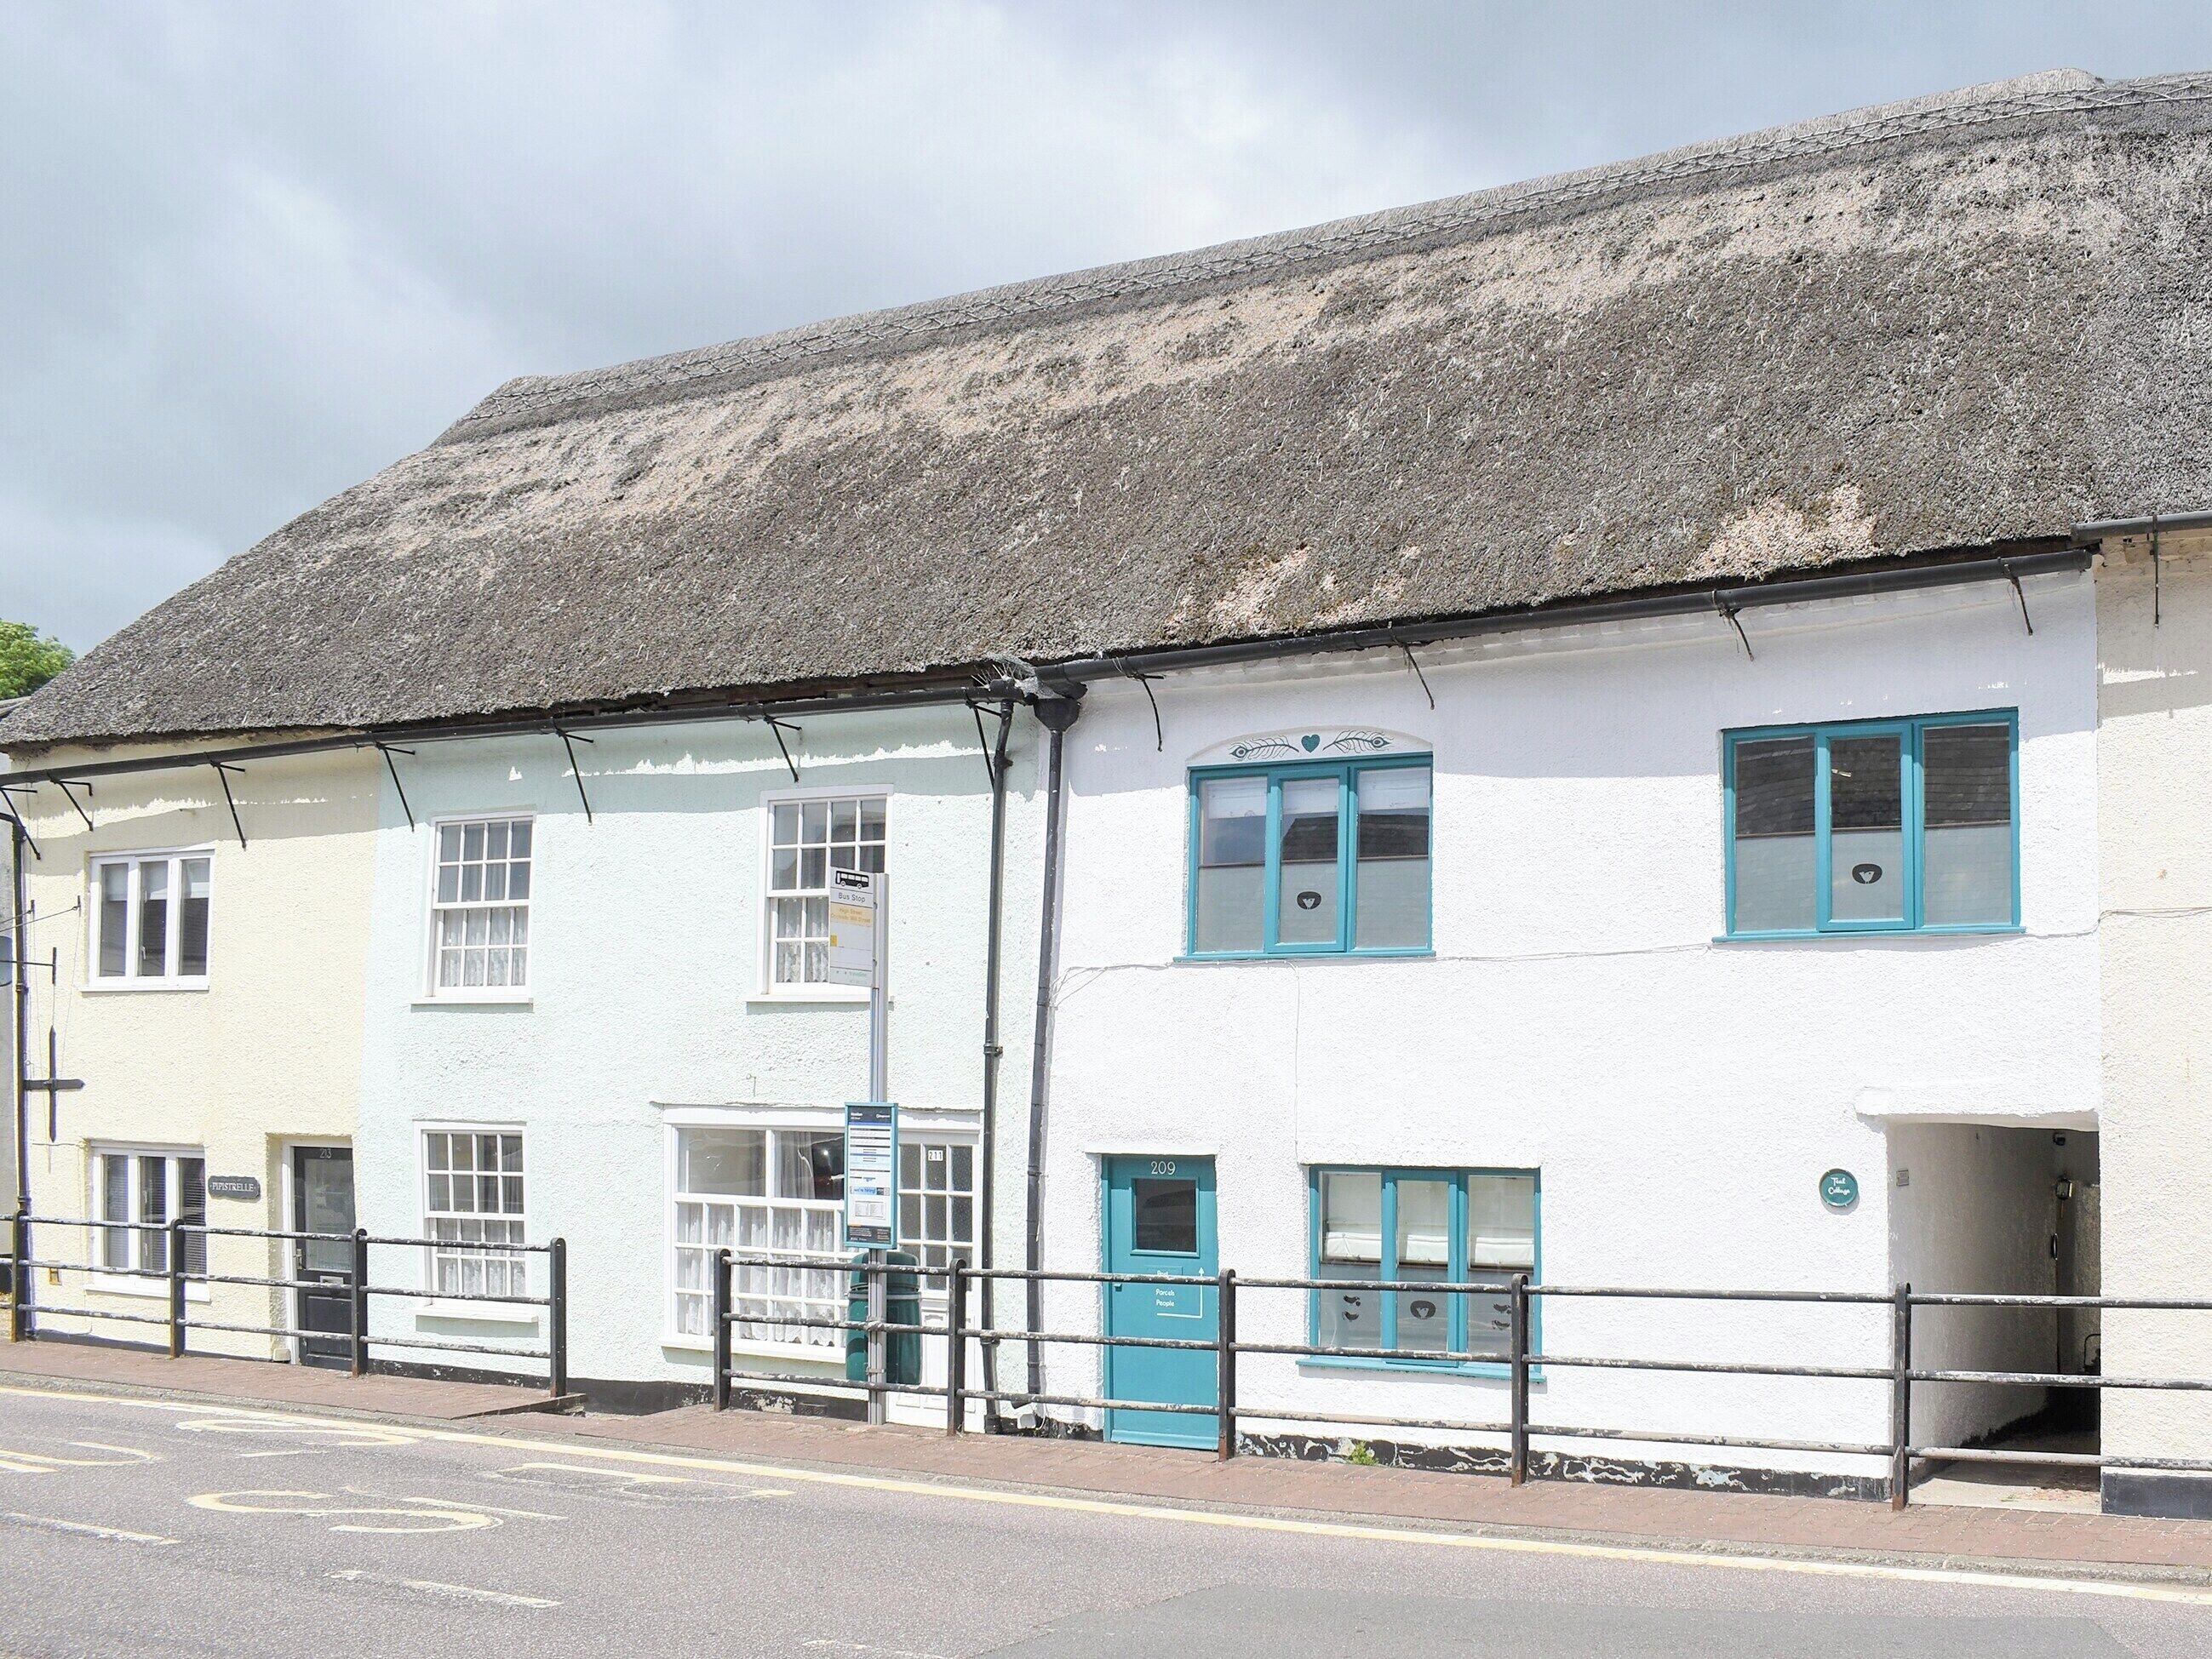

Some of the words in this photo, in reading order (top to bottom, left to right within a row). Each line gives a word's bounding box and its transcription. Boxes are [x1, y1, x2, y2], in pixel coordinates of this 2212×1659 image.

[839, 892, 850, 901] Bus
[851, 894, 866, 903] Stop
[319, 1148, 332, 1158] 213
[1150, 1161, 1176, 1175] 209
[212, 1181, 255, 1192] PIPISTRELLE
[1831, 1176, 1846, 1187] Teal
[1827, 1187, 1851, 1195] Cottage
[1155, 1288, 1175, 1296] Parcels
[1155, 1299, 1175, 1307] People
